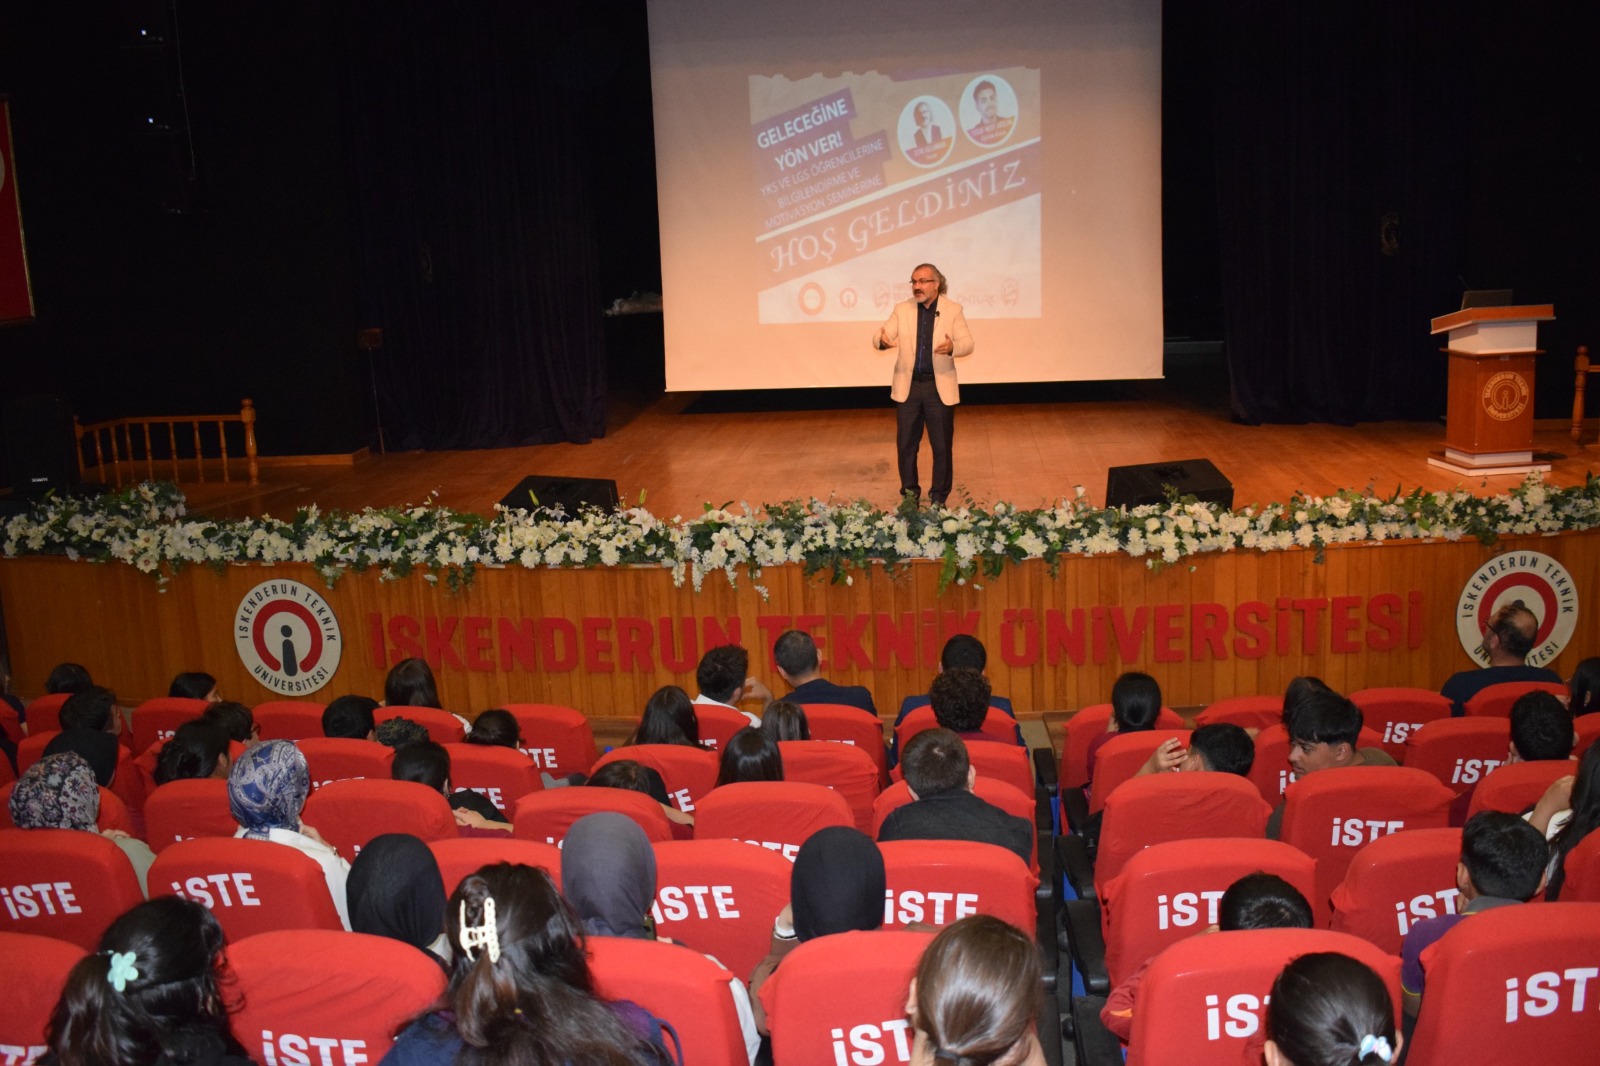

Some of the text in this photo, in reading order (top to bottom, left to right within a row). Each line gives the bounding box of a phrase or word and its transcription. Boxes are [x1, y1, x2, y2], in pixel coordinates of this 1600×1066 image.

[757, 98, 848, 148] GELECEĞİNE
[774, 131, 843, 171] YÖN VER!
[760, 181, 778, 196] YKS
[778, 176, 791, 189] VE
[791, 168, 810, 184] LGS
[765, 174, 882, 229] MOTİVASYON SEMİNERİNE
[777, 166, 861, 208] BİLGİLENDİRME VE
[770, 160, 1027, 273] HOŞ GELDİNİZ
[369, 611, 742, 674] İSKENDERUN
[1000, 591, 1425, 668] ÜNİVERSİTESİ
